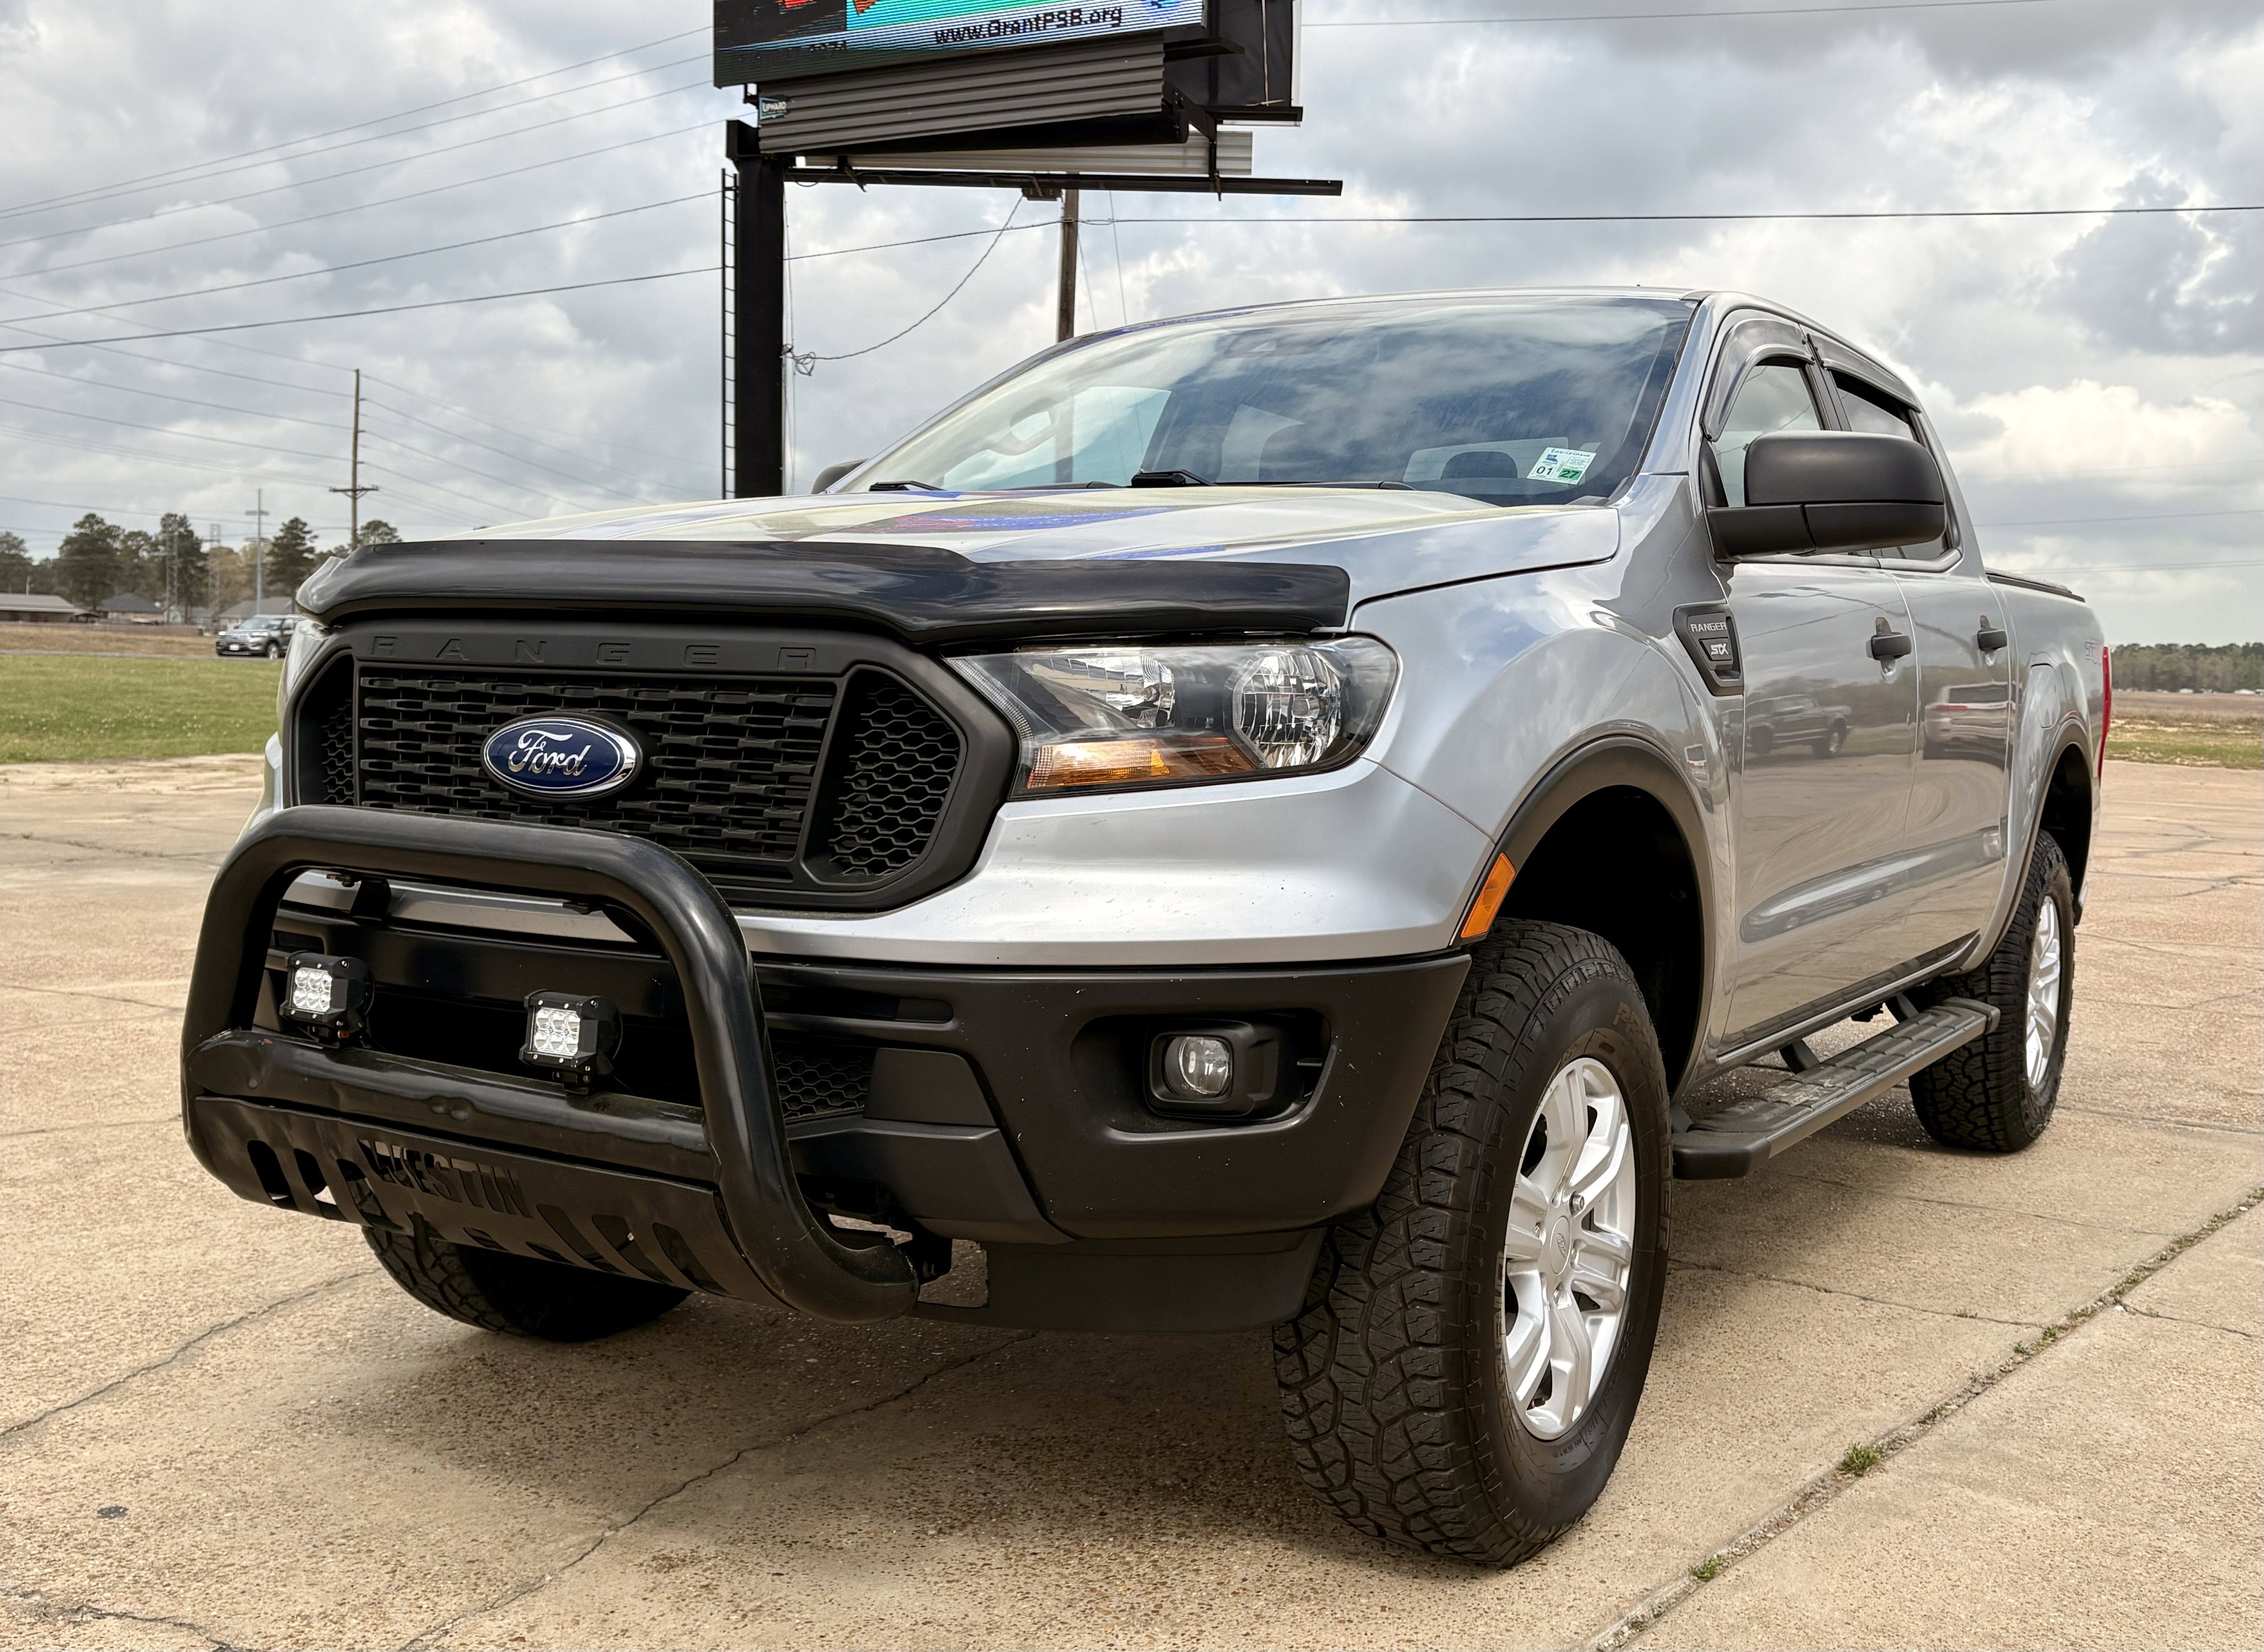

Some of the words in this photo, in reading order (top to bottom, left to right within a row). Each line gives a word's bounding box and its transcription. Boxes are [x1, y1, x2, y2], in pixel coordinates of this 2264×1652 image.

[935, 7, 1122, 44] www.GrantPSB.org
[1536, 467, 1553, 475] 01
[1560, 470, 1580, 478] 27
[1690, 622, 1728, 632] RANGER
[372, 636, 816, 671] RANGER
[1710, 643, 1729, 655] STX
[508, 730, 592, 777] Ford
[357, 1139, 534, 1219] WESTIN
